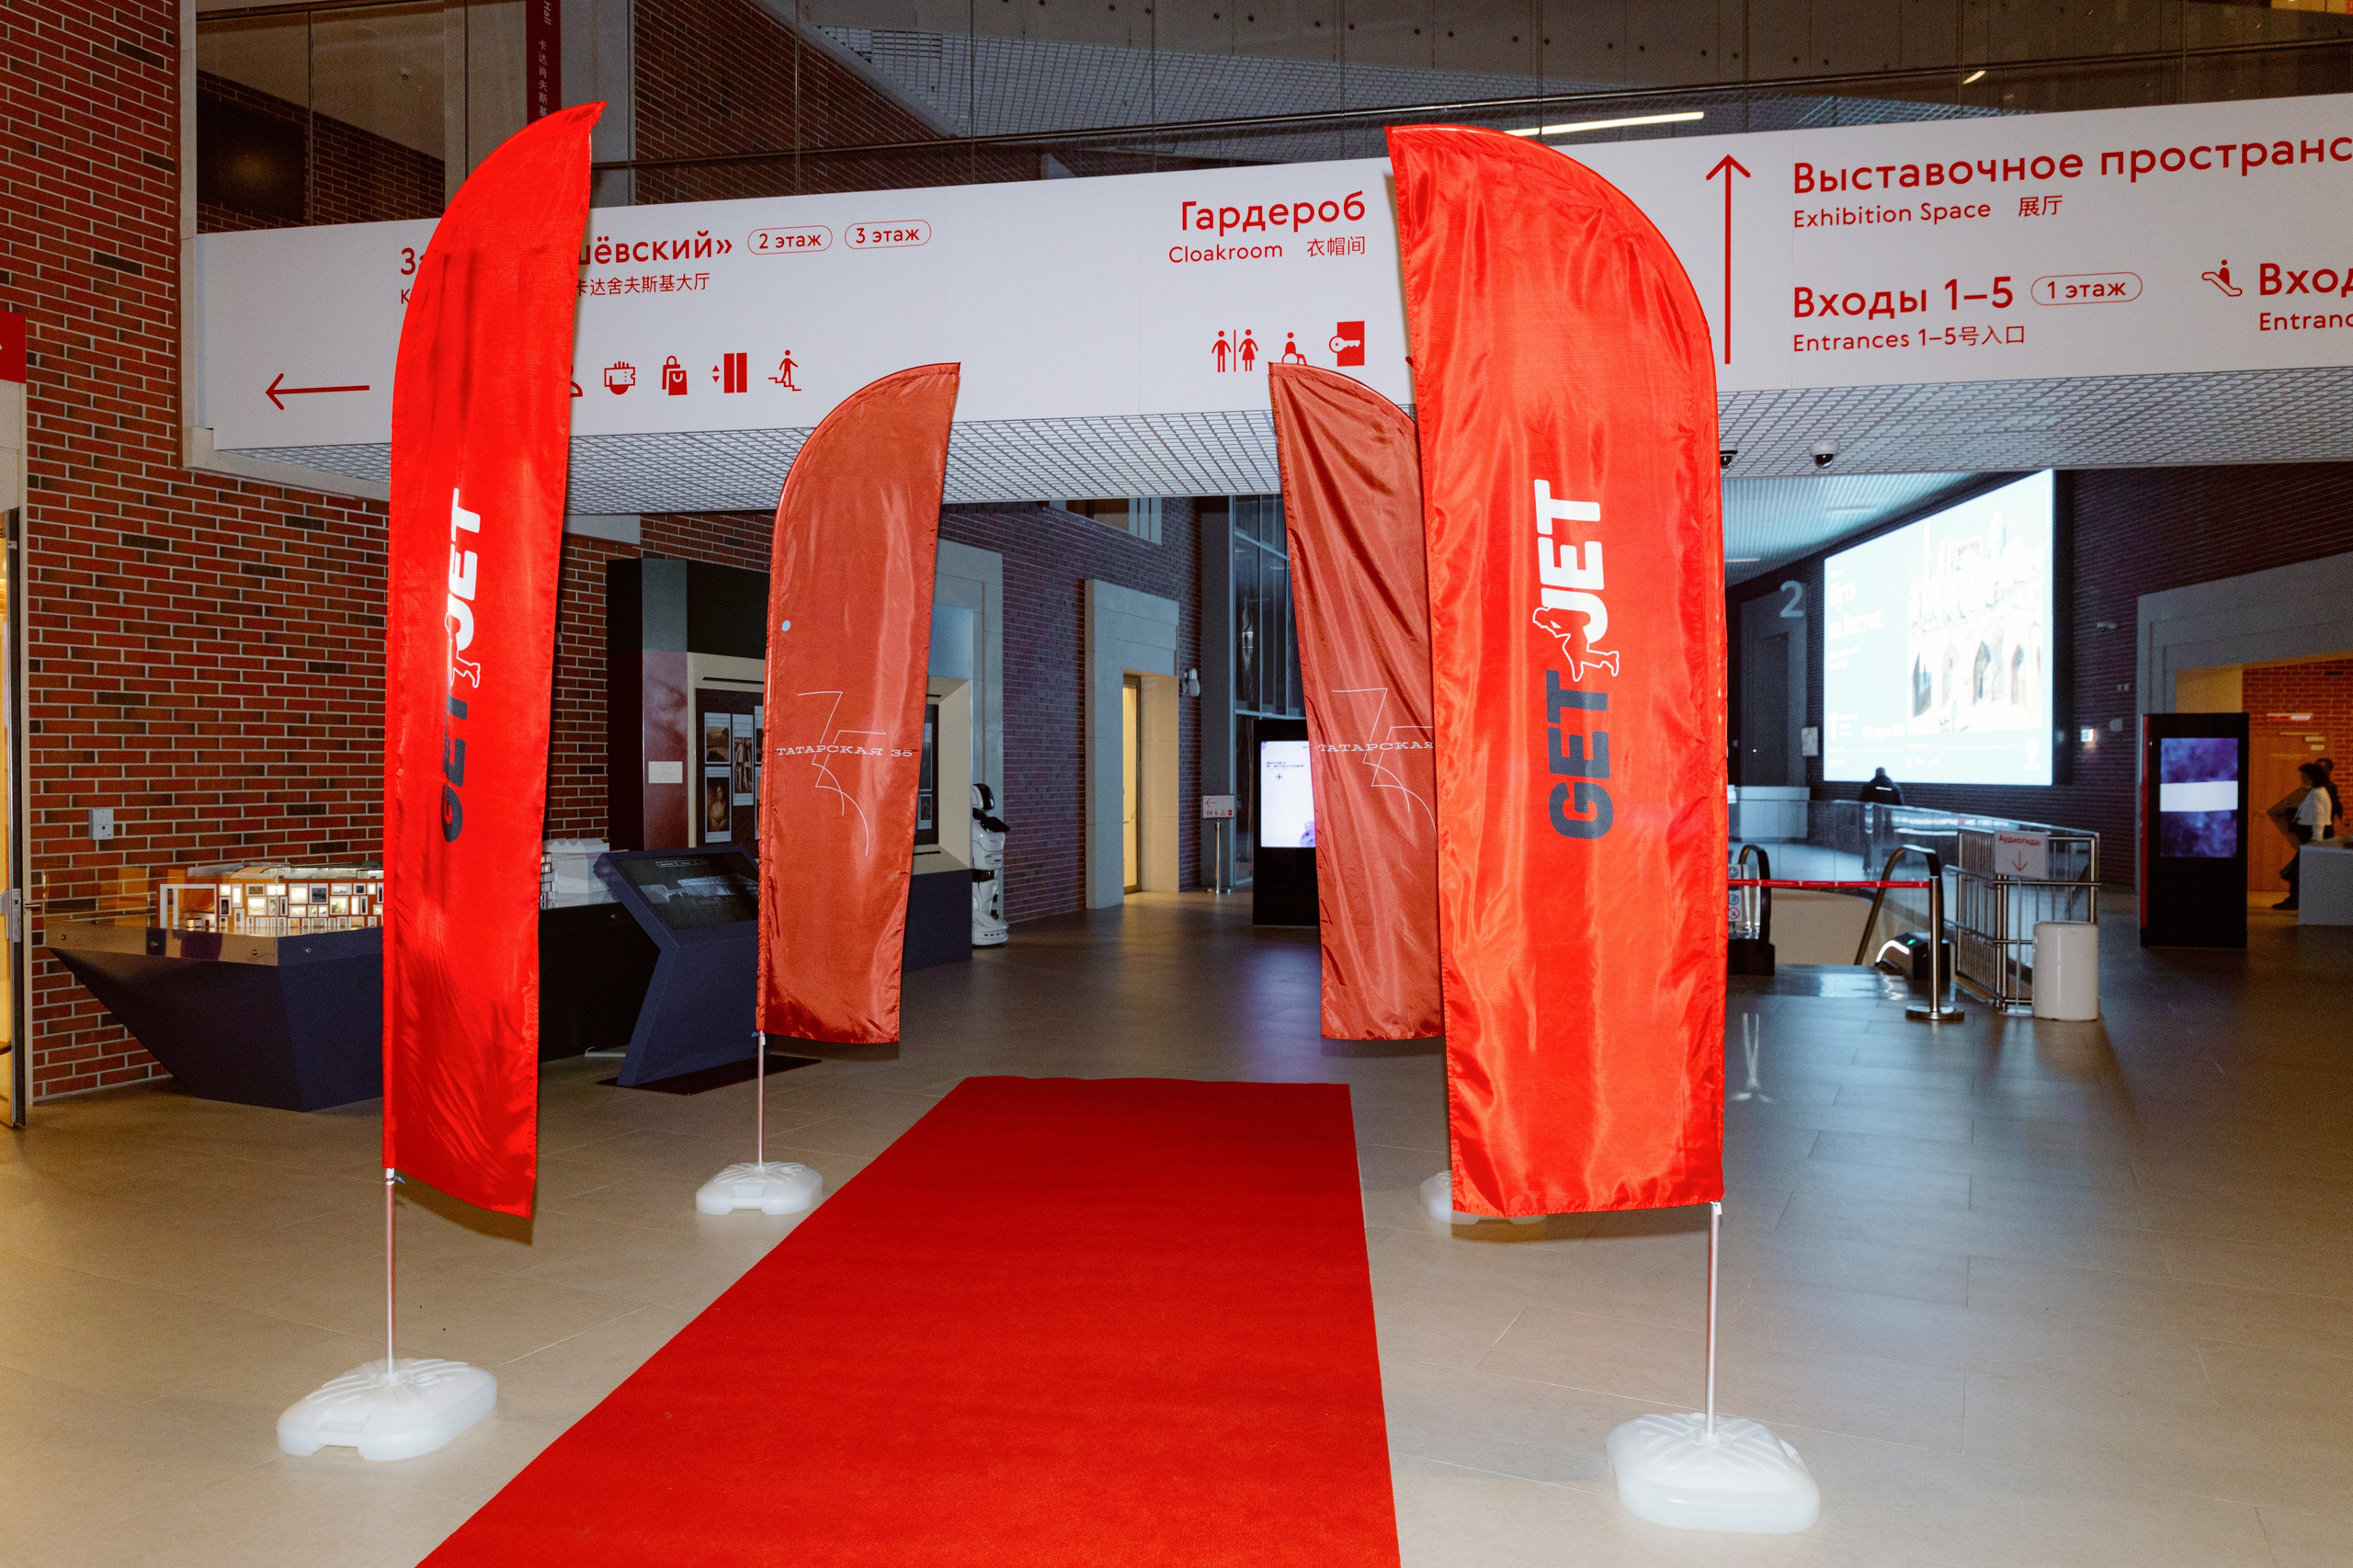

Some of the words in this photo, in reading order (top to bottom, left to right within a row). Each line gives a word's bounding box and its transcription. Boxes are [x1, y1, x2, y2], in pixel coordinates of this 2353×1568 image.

[1794, 154, 2084, 194] Выставочное
[2101, 137, 2353, 183] пространс
[1182, 190, 1365, 237] Гардероб
[1794, 205, 1912, 228] Exhibition
[1920, 203, 1992, 224] Space
[2018, 195, 2063, 217] 展厅
[758, 233, 768, 249] 2
[775, 234, 822, 248] этаж
[856, 228, 866, 244] 3
[872, 229, 920, 243] этаж
[1169, 244, 1283, 263] Cloakroom
[1307, 236, 1366, 257] 衣帽间
[401, 248, 429, 275] З
[1794, 287, 1927, 320] Входы
[1944, 277, 2014, 310] 1–5
[2047, 281, 2055, 299] 1
[2065, 282, 2126, 298] этаж
[1794, 335, 1909, 352] Entrances
[1779, 580, 1803, 618] 2
[776, 744, 883, 756] ТАТАРСКАЯ
[890, 749, 913, 757] 35
[1318, 741, 1434, 753] ТАТАРСКАЯ
[1998, 835, 2040, 846] Аудиогиды
